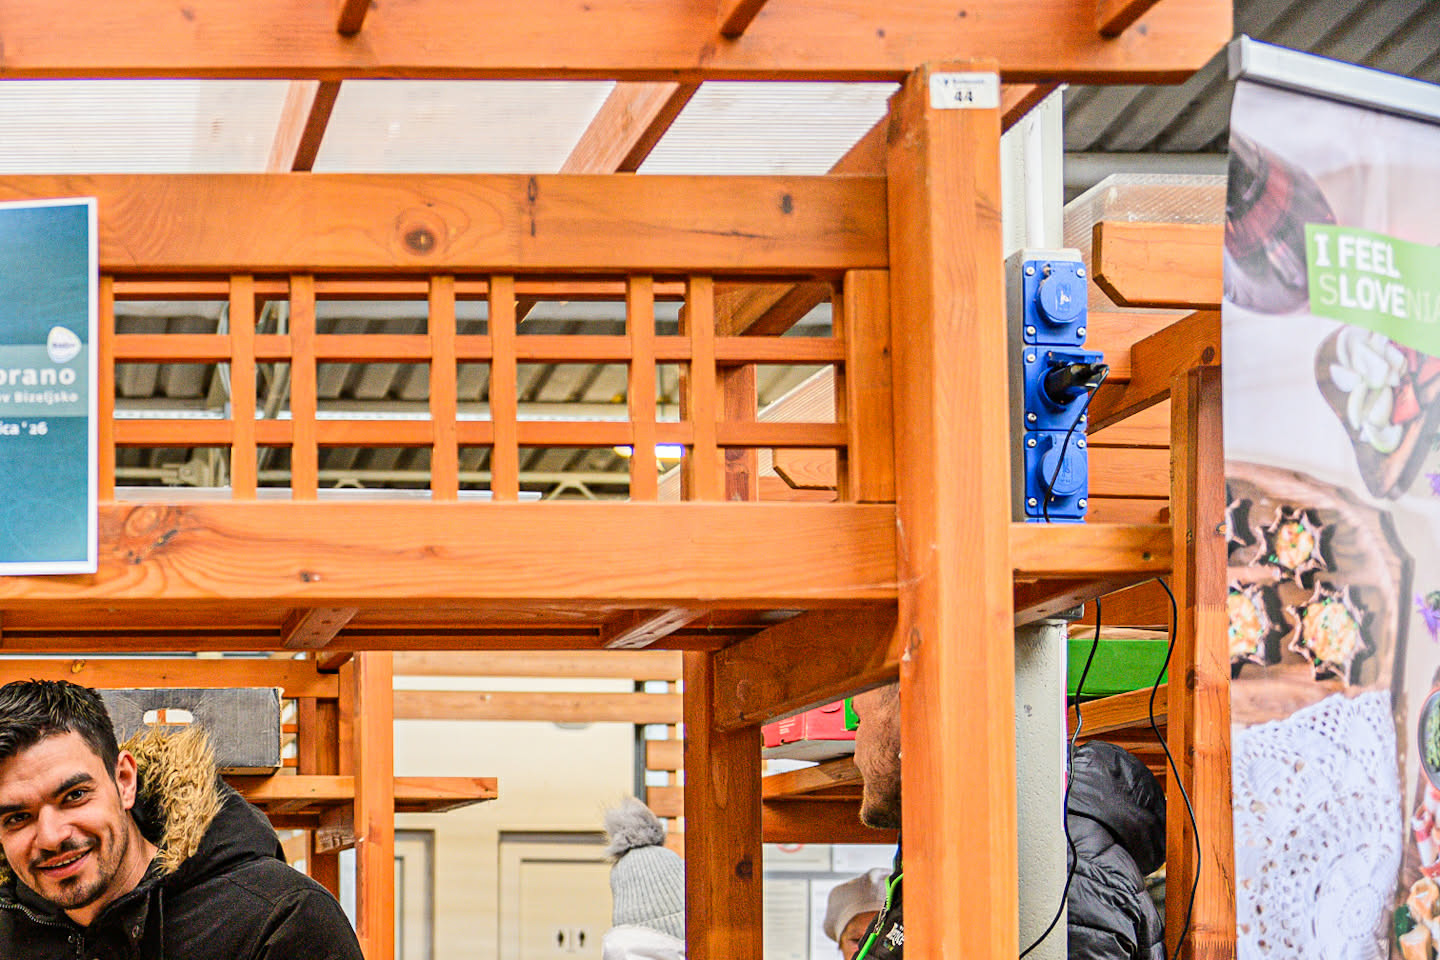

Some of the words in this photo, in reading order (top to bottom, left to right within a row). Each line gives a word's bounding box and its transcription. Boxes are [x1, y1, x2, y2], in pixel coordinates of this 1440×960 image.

[1314, 232, 1331, 267] I
[1337, 235, 1401, 279] FEEL
[13, 390, 80, 406] Bizeljsko
